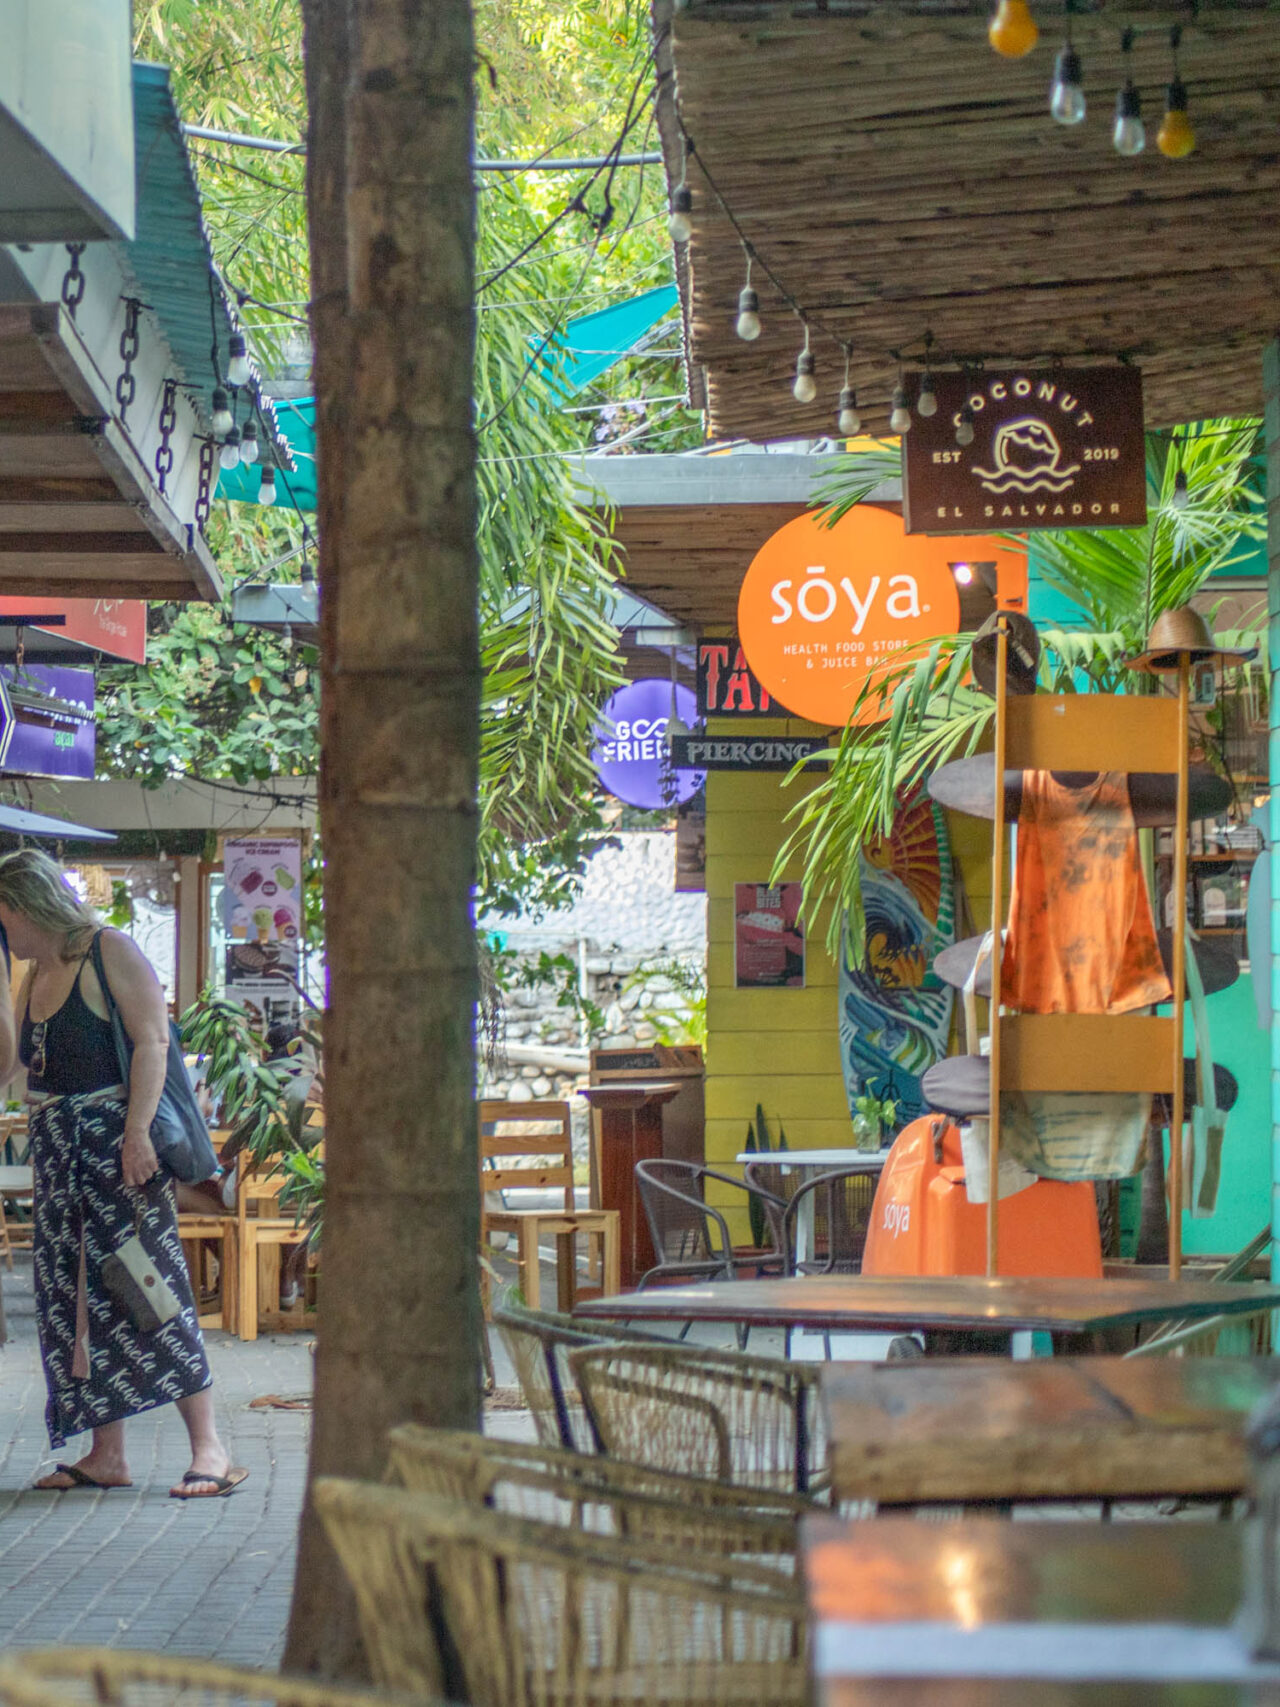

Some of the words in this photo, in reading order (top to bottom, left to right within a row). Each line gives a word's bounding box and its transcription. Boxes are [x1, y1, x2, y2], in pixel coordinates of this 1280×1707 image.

[932, 451, 962, 464] EST
[1083, 448, 1120, 461] 2019
[937, 506, 963, 518] EL
[984, 503, 1121, 518] SALVADOR
[783, 643, 829, 656] HEALTH
[836, 641, 865, 653] FOOD
[872, 639, 910, 651] STORE
[806, 659, 814, 669] &
[822, 657, 858, 669] JUICE
[686, 741, 811, 765] PIERCING
[81, 1219, 113, 1264] Kawel
[109, 1320, 157, 1373] Kawela
[154, 1322, 203, 1375] Kawela
[79, 1382, 112, 1419] wela
[107, 1368, 157, 1411] Kawel
